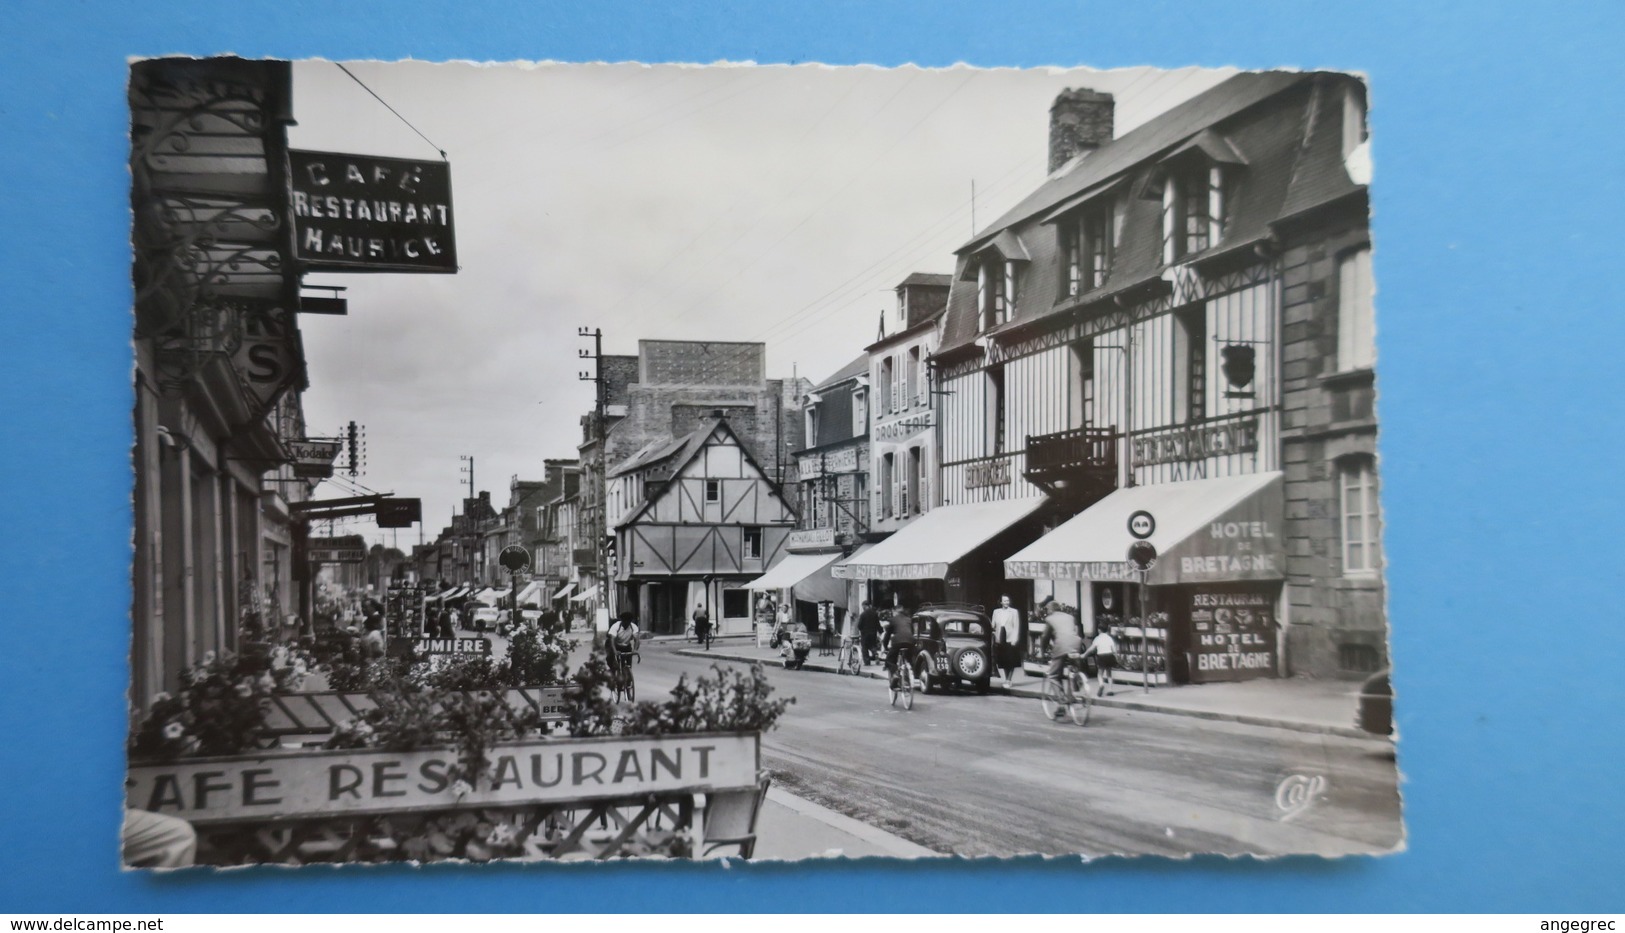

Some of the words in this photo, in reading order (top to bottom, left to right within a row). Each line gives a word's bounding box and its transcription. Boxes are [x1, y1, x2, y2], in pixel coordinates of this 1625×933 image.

[293, 190, 449, 226] RESTAURANT
[304, 227, 442, 258] MAURICE
[875, 413, 931, 442] DROGUERIE
[1132, 418, 1259, 468] BRETAGNE
[1211, 521, 1275, 539] HOTEL
[1238, 542, 1251, 551] DE
[856, 565, 880, 579] HOTEL
[882, 564, 934, 579] RESTAURANT
[1005, 561, 1045, 578] HOTEL
[1181, 554, 1276, 574] BRETAGNE
[1200, 633, 1265, 646] HOTEL
[1198, 652, 1271, 670] BRETAGNE
